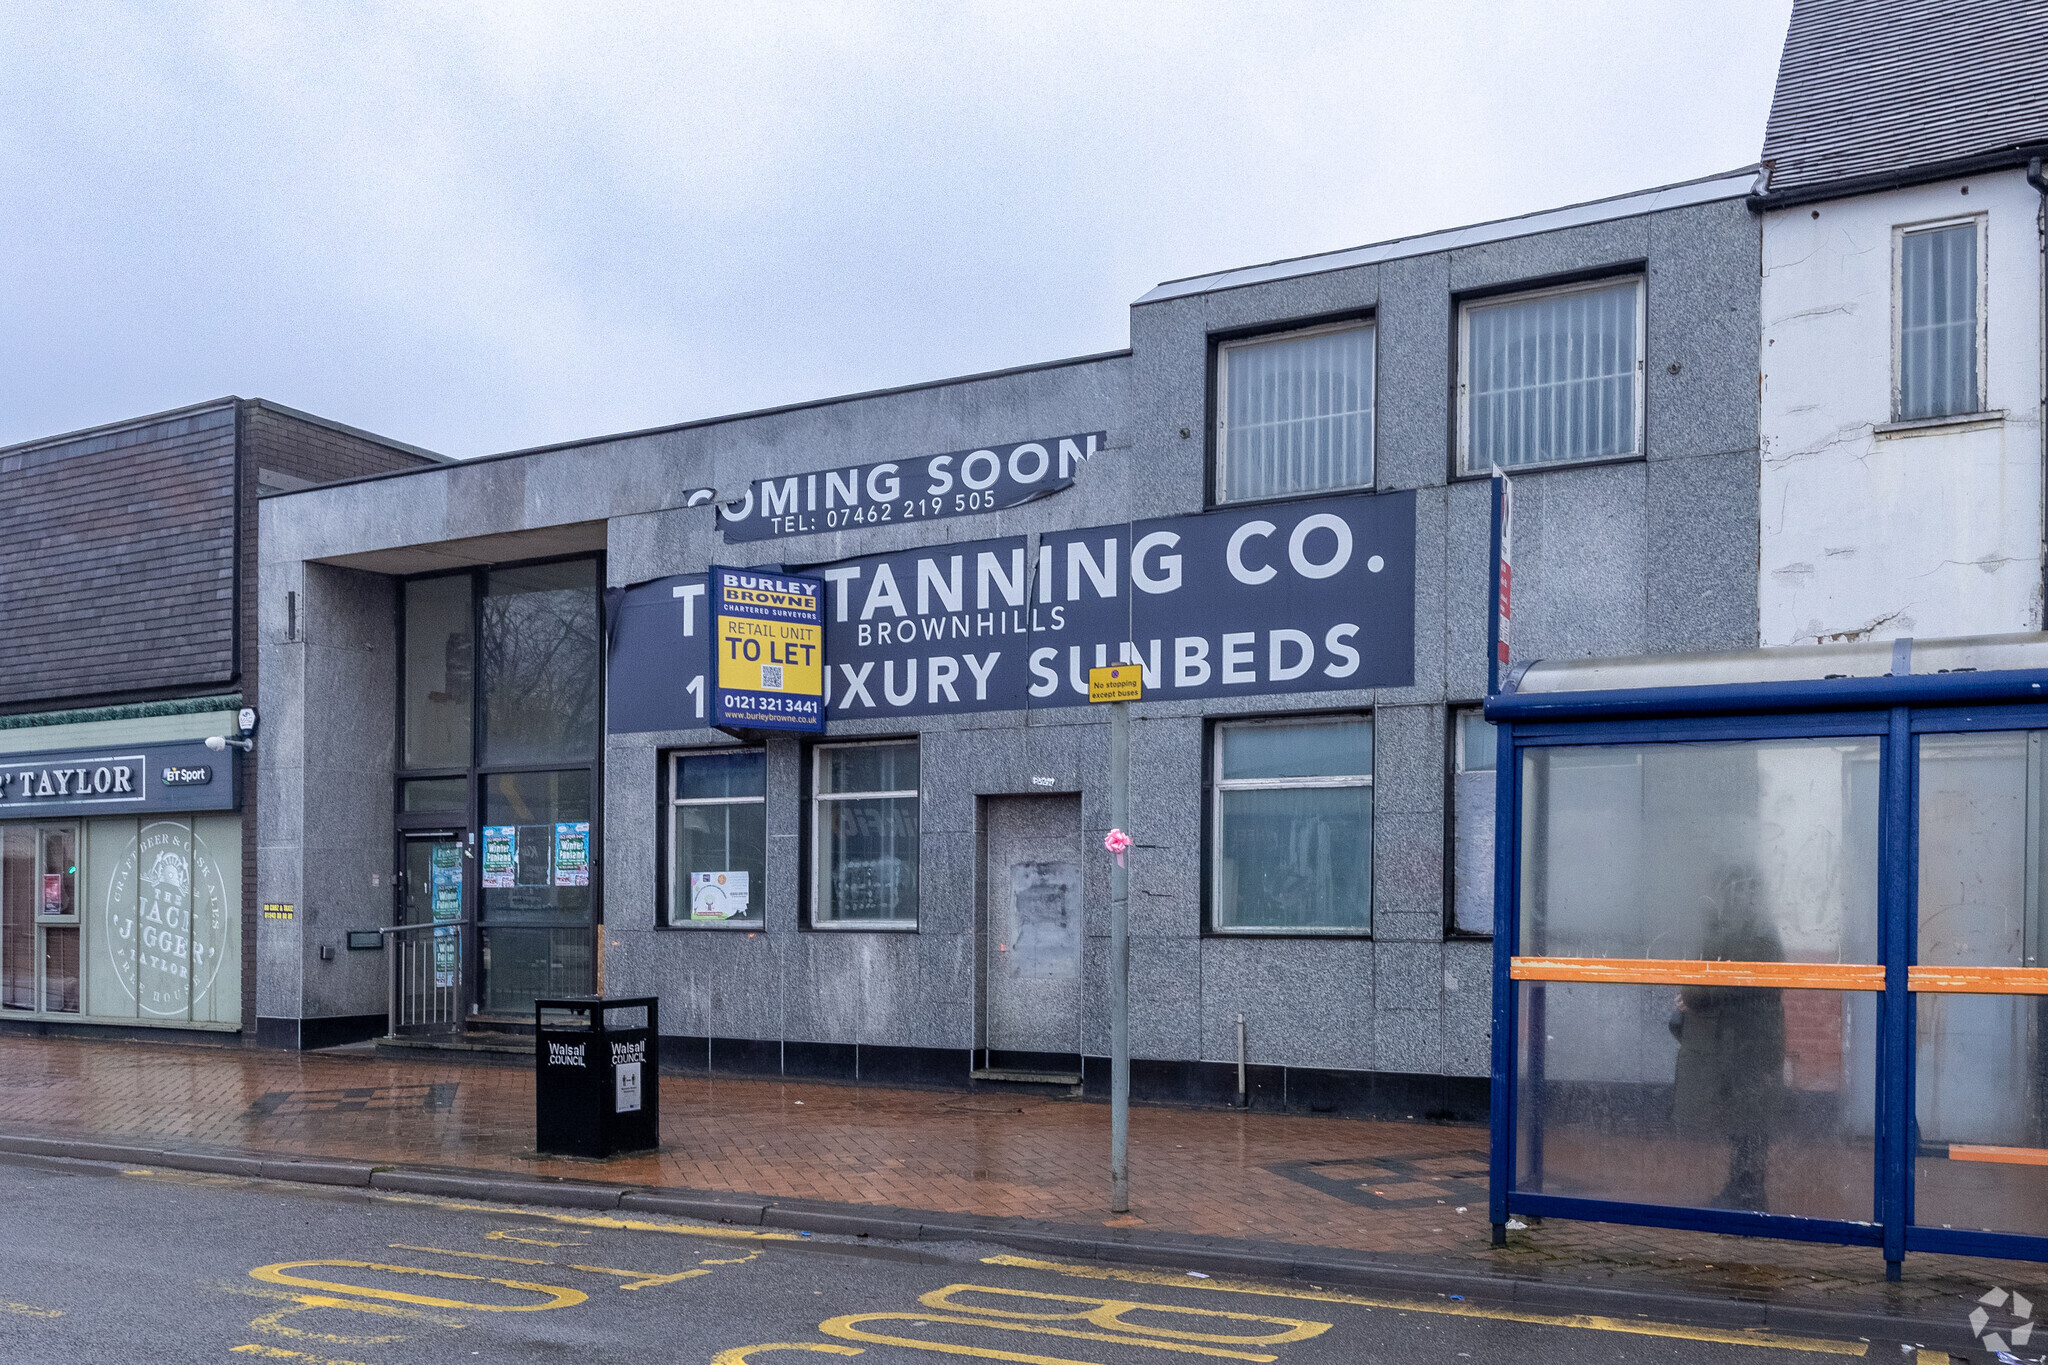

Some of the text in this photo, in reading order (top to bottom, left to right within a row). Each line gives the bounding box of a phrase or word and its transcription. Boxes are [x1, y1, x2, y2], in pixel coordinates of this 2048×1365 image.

[927, 435, 1098, 496] SOON
[771, 490, 995, 535] TEL: 07462 219 505
[825, 531, 1183, 623] TANNING
[1226, 513, 1385, 585] CO.
[723, 574, 817, 595] BURLEY
[726, 589, 815, 609] BROWNE
[723, 604, 817, 620] CHARTERED SURVEYORS
[728, 621, 813, 641] RETAIL UNIT
[858, 605, 1066, 646] BROWNHILLS
[725, 637, 816, 666] TO LET
[1028, 622, 1361, 698] SUNBEDS
[1106, 680, 1137, 688] stopping
[724, 694, 818, 714] 0121 321 3441
[1092, 691, 1116, 699] except
[724, 711, 817, 724] www.burleybrowne.co.uk
[20, 765, 134, 798] TAYLOR
[166, 767, 205, 782] BT Sport
[488, 843, 510, 853] Winter
[561, 840, 584, 850] Winter
[486, 853, 512, 863] Funland
[559, 850, 585, 861] Funland
[114, 850, 138, 903] CRAFT
[140, 833, 170, 853] BEER
[172, 836, 181, 847] &
[207, 883, 220, 930] ALES
[154, 888, 182, 907] THE
[130, 948, 189, 980] TAYLOR
[549, 1042, 585, 1057] Walsall
[612, 1040, 645, 1055] Walsall
[549, 1055, 585, 1067] COUNCIL
[611, 1053, 646, 1066] COUNCIL
